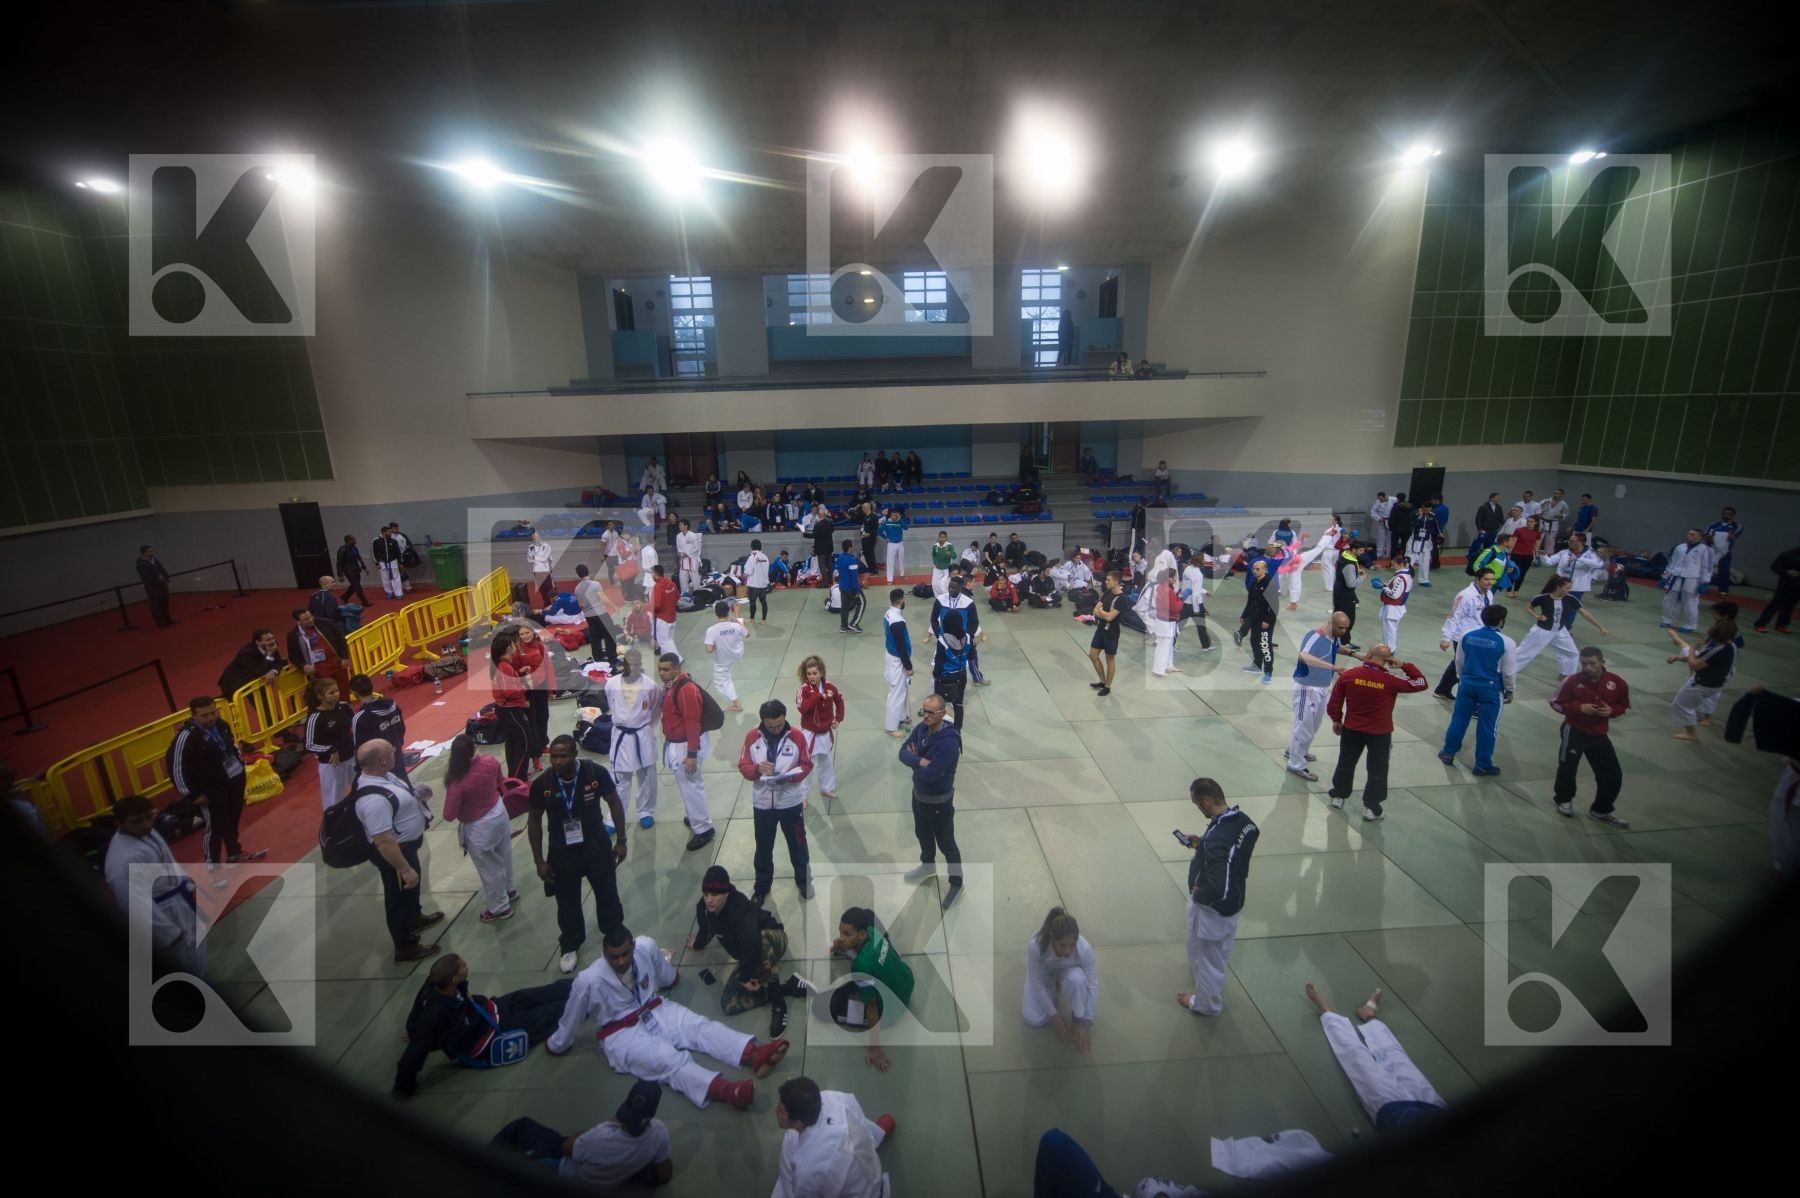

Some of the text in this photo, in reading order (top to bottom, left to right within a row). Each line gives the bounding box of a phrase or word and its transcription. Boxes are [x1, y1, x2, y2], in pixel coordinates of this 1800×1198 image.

[720, 628, 735, 636] JAPAN
[1260, 632, 1271, 662] adidas
[1354, 678, 1384, 689] BELGIUM
[1235, 832, 1245, 849] SAN
